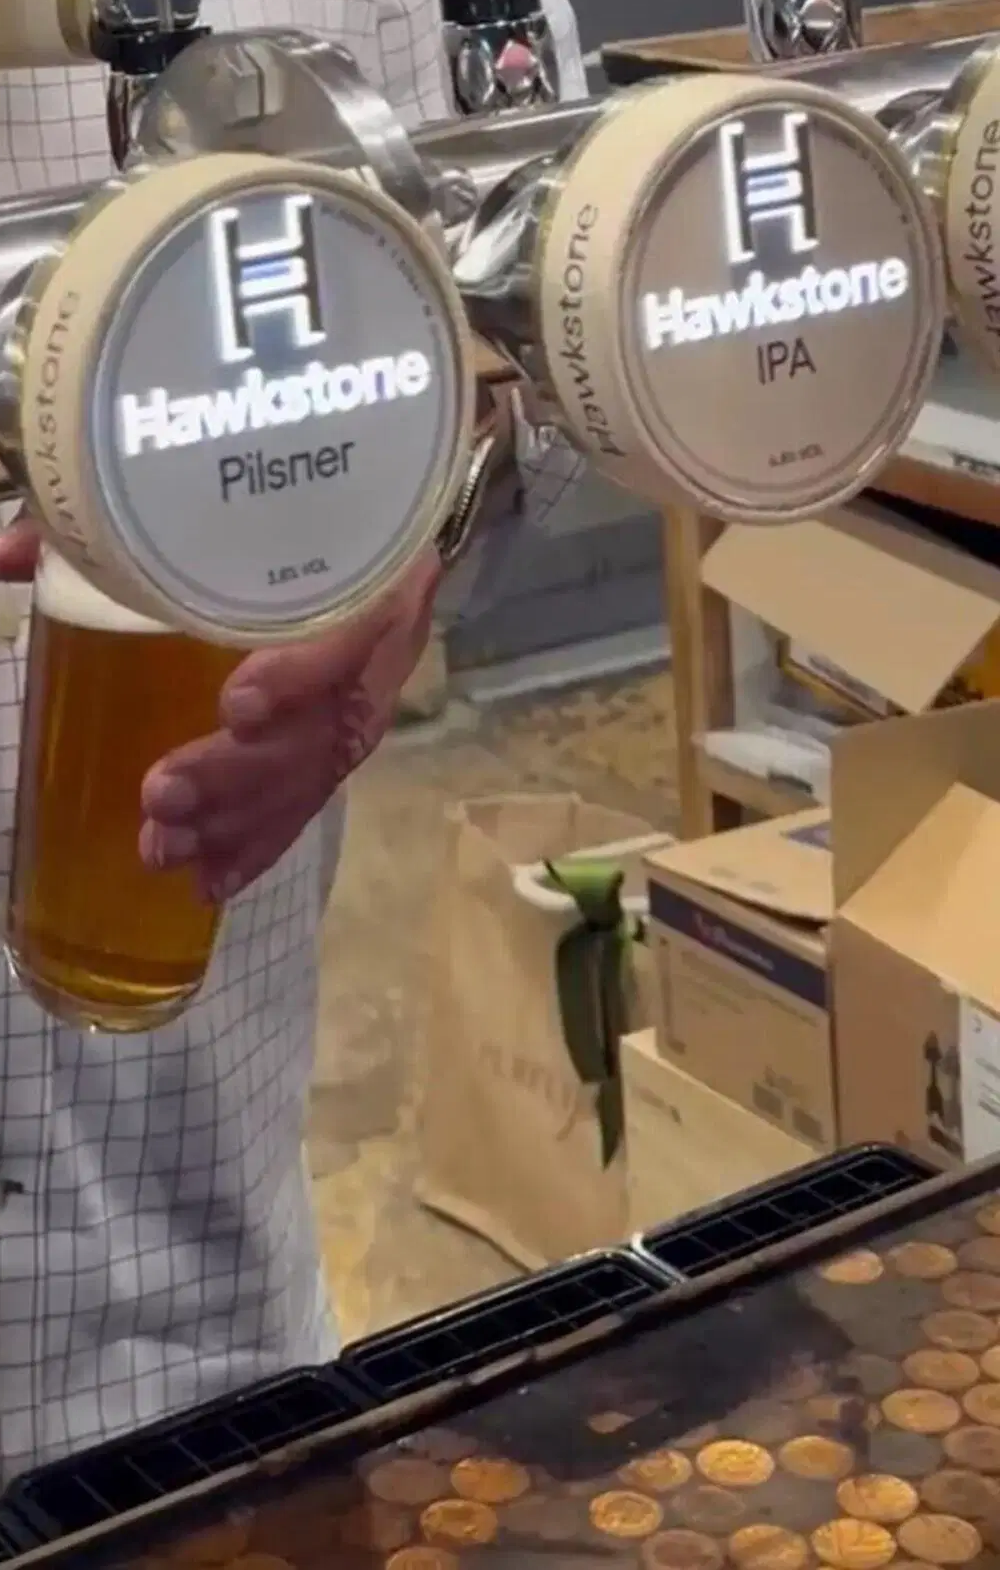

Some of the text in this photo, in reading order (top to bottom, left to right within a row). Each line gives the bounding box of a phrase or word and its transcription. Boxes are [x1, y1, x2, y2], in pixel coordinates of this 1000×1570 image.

[963, 119, 1000, 350] awkstone
[558, 203, 627, 457] Hawkstone
[643, 257, 910, 350] Hawkstone
[119, 350, 431, 458] Hawkstone
[757, 337, 818, 387] IPA
[218, 441, 356, 503] Pilsner
